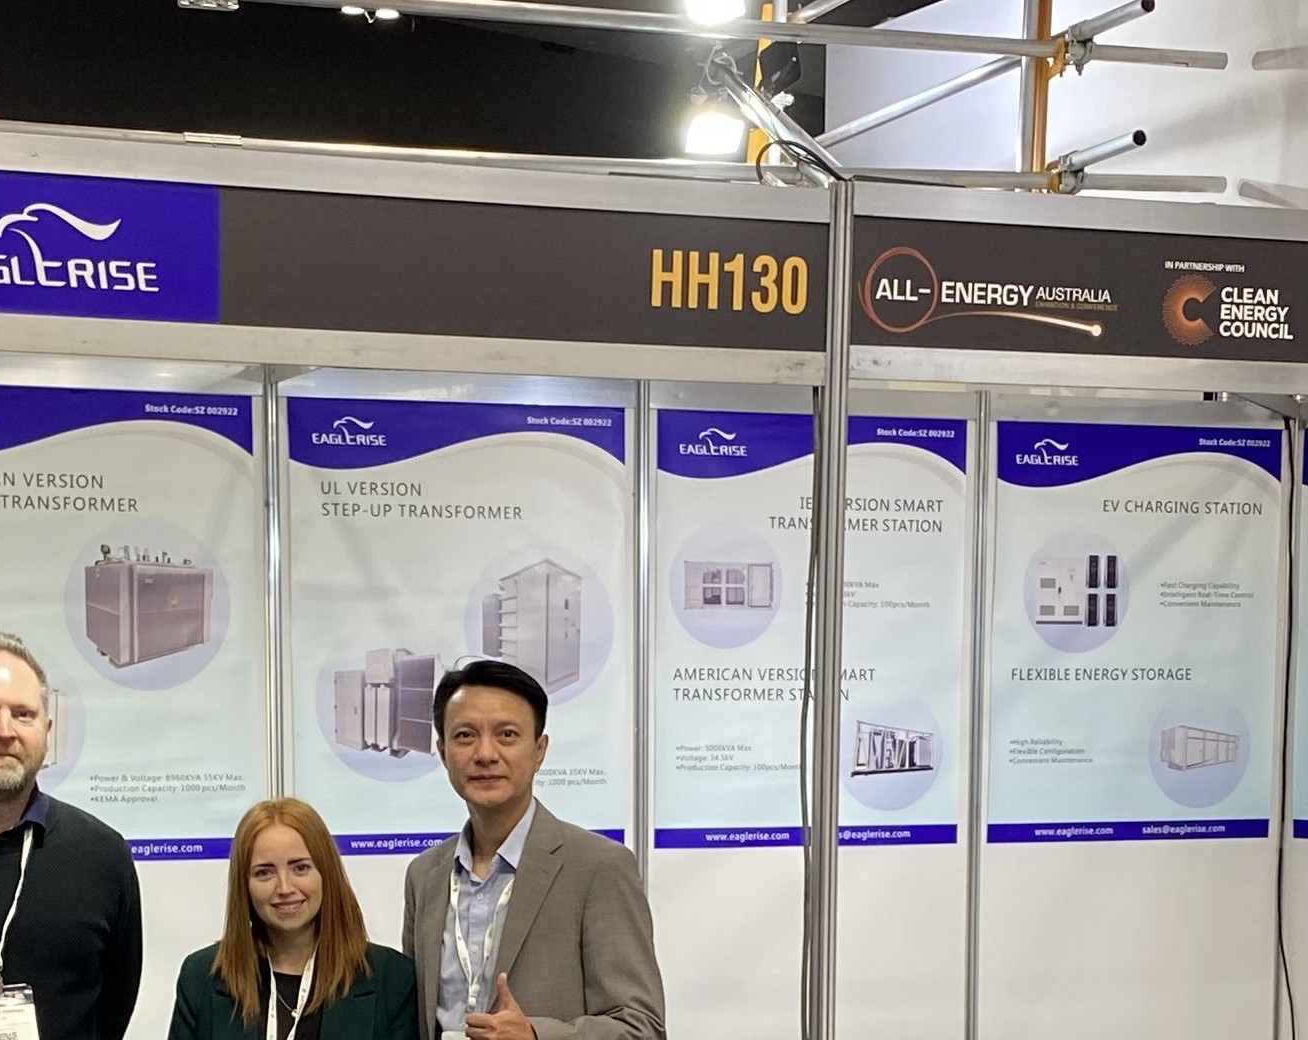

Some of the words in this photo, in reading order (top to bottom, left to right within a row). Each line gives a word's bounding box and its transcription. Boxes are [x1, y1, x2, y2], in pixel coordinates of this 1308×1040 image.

[1165, 261, 1174, 269] IN
[1175, 262, 1224, 272] PARTNERSHIP
[1225, 264, 1245, 272] WITH
[650, 248, 808, 315] HH130
[875, 278, 931, 301] ALL-
[941, 281, 1035, 306] ENERGY
[1036, 287, 1112, 303] AUSTRALIA
[1221, 287, 1279, 305] CLEAN
[1220, 304, 1289, 322] ENERGY
[1219, 321, 1293, 340] COUNCIL
[145, 404, 169, 414] Stock
[312, 432, 387, 447] EAGLERISE
[679, 443, 747, 457] EAGLERISE
[1016, 454, 1079, 466] EAGLERISE
[23, 472, 104, 489] VERSION
[321, 481, 341, 495] UL
[348, 482, 422, 497] VERSION
[1, 494, 138, 512] TRANSFORMER
[844, 498, 890, 512] RSION
[894, 499, 943, 512] SMART
[1103, 500, 1121, 513] EV
[1125, 500, 1200, 514] CHARGING
[1205, 502, 1262, 515] STATION
[321, 502, 392, 518] STEP-UP
[400, 504, 522, 520] TRANSFORMER
[883, 519, 942, 533] STATION
[673, 668, 752, 681] AMERICAN
[839, 668, 876, 681] MART
[1011, 668, 1070, 681] FLEXIBLE
[1074, 668, 1127, 681] ENERGY
[1132, 668, 1191, 681] STORAGE
[673, 688, 784, 702] TRANSFORMER
[202, 784, 246, 792] pcs/Month
[121, 795, 158, 804] Approval
[705, 831, 789, 842] www.eaglerise.com
[837, 829, 911, 840] s@eaglerise.com
[1034, 826, 1114, 837] www.eaglerise.com
[1142, 824, 1226, 835] sales@eaglerise.com
[131, 842, 203, 855] eaglerise.com
